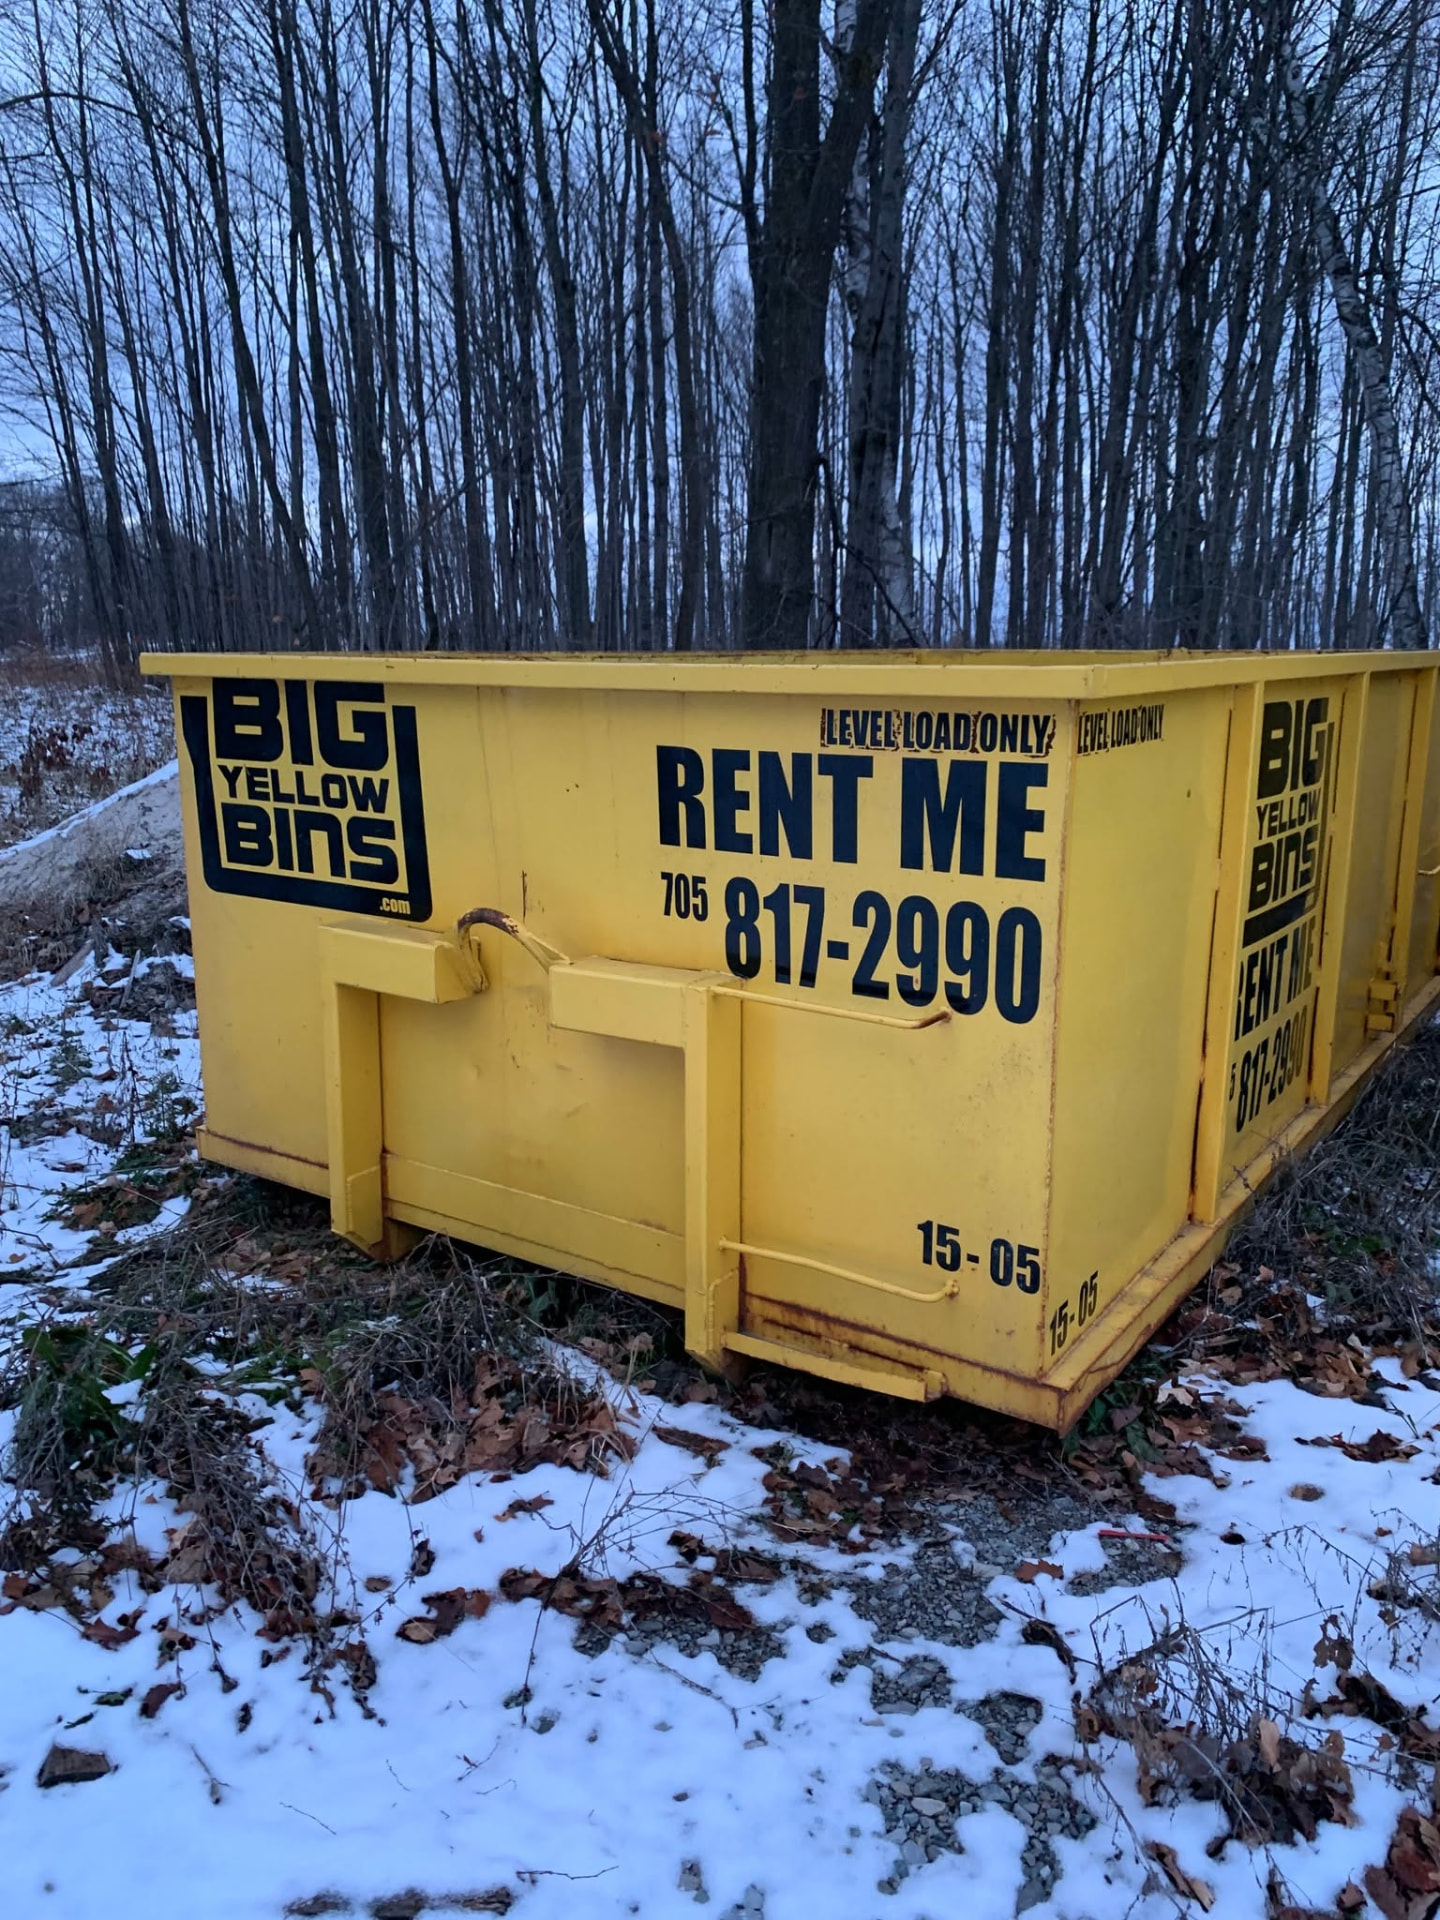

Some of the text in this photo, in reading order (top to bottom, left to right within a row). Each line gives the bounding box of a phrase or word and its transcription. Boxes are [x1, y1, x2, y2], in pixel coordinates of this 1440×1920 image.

[212, 677, 389, 771] BIG
[827, 709, 1051, 754] LEVEL LOAD ONLY
[1077, 704, 1165, 754] LEVEL LOAD ONLY
[1257, 697, 1329, 800] BIG
[217, 764, 390, 814] YELLOW
[656, 745, 1049, 882] RENT ME
[1256, 788, 1322, 840] YELLOW
[378, 897, 411, 915] .com
[660, 871, 1043, 1025] 705 817-2990
[1287, 915, 1316, 1004] ME
[1236, 1004, 1308, 1133] 817-2990
